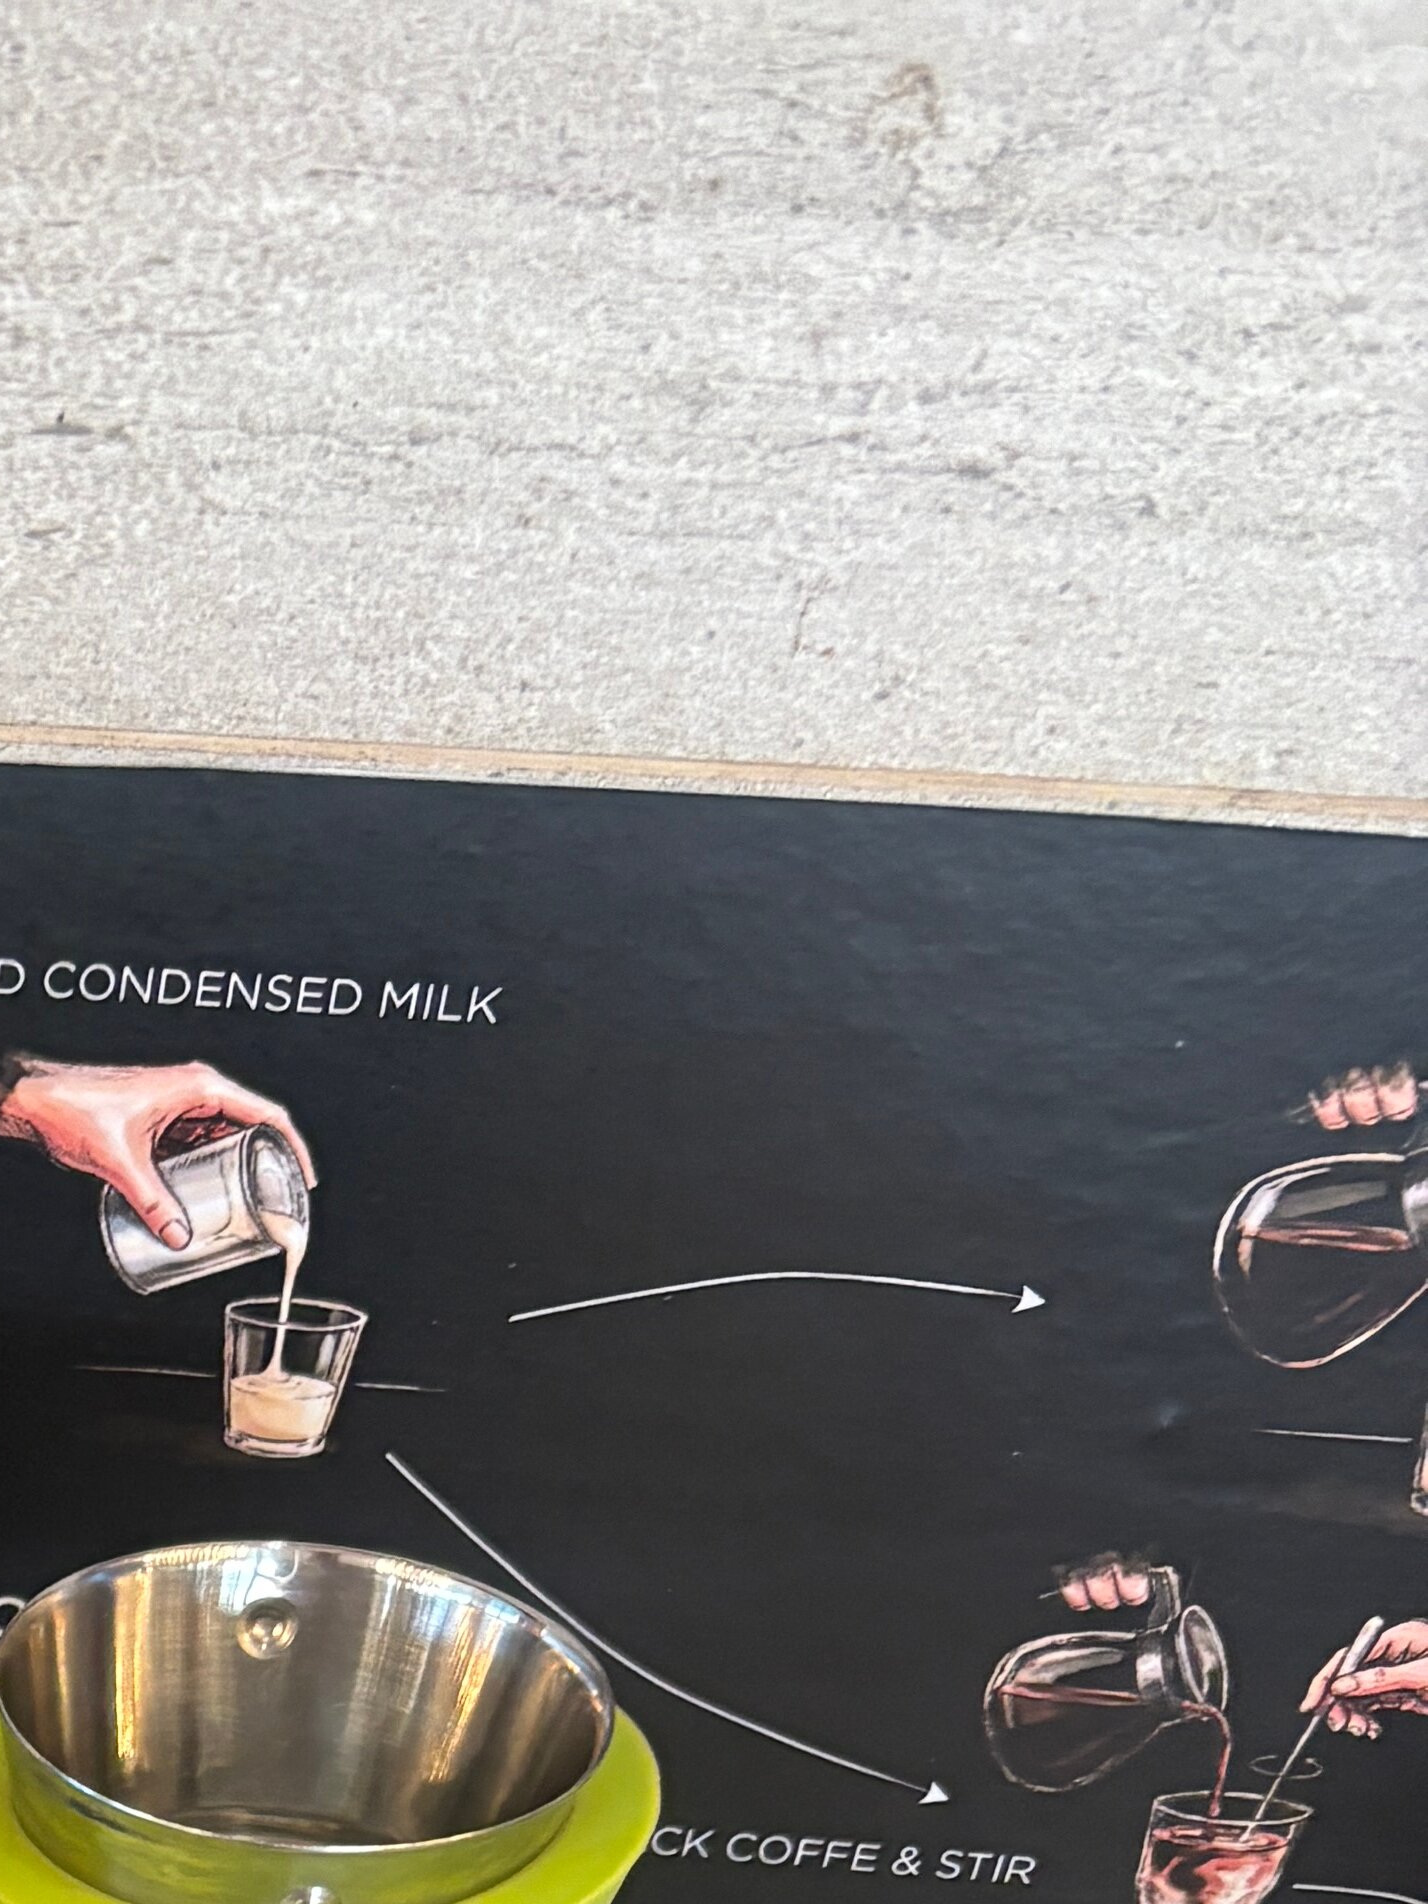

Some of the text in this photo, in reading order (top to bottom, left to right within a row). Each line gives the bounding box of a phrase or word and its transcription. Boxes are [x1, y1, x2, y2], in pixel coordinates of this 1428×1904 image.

[42, 960, 363, 1017] CONDENSED
[379, 981, 505, 1025] MILK
[650, 1826, 1037, 1886] CK COFFE & STIR
